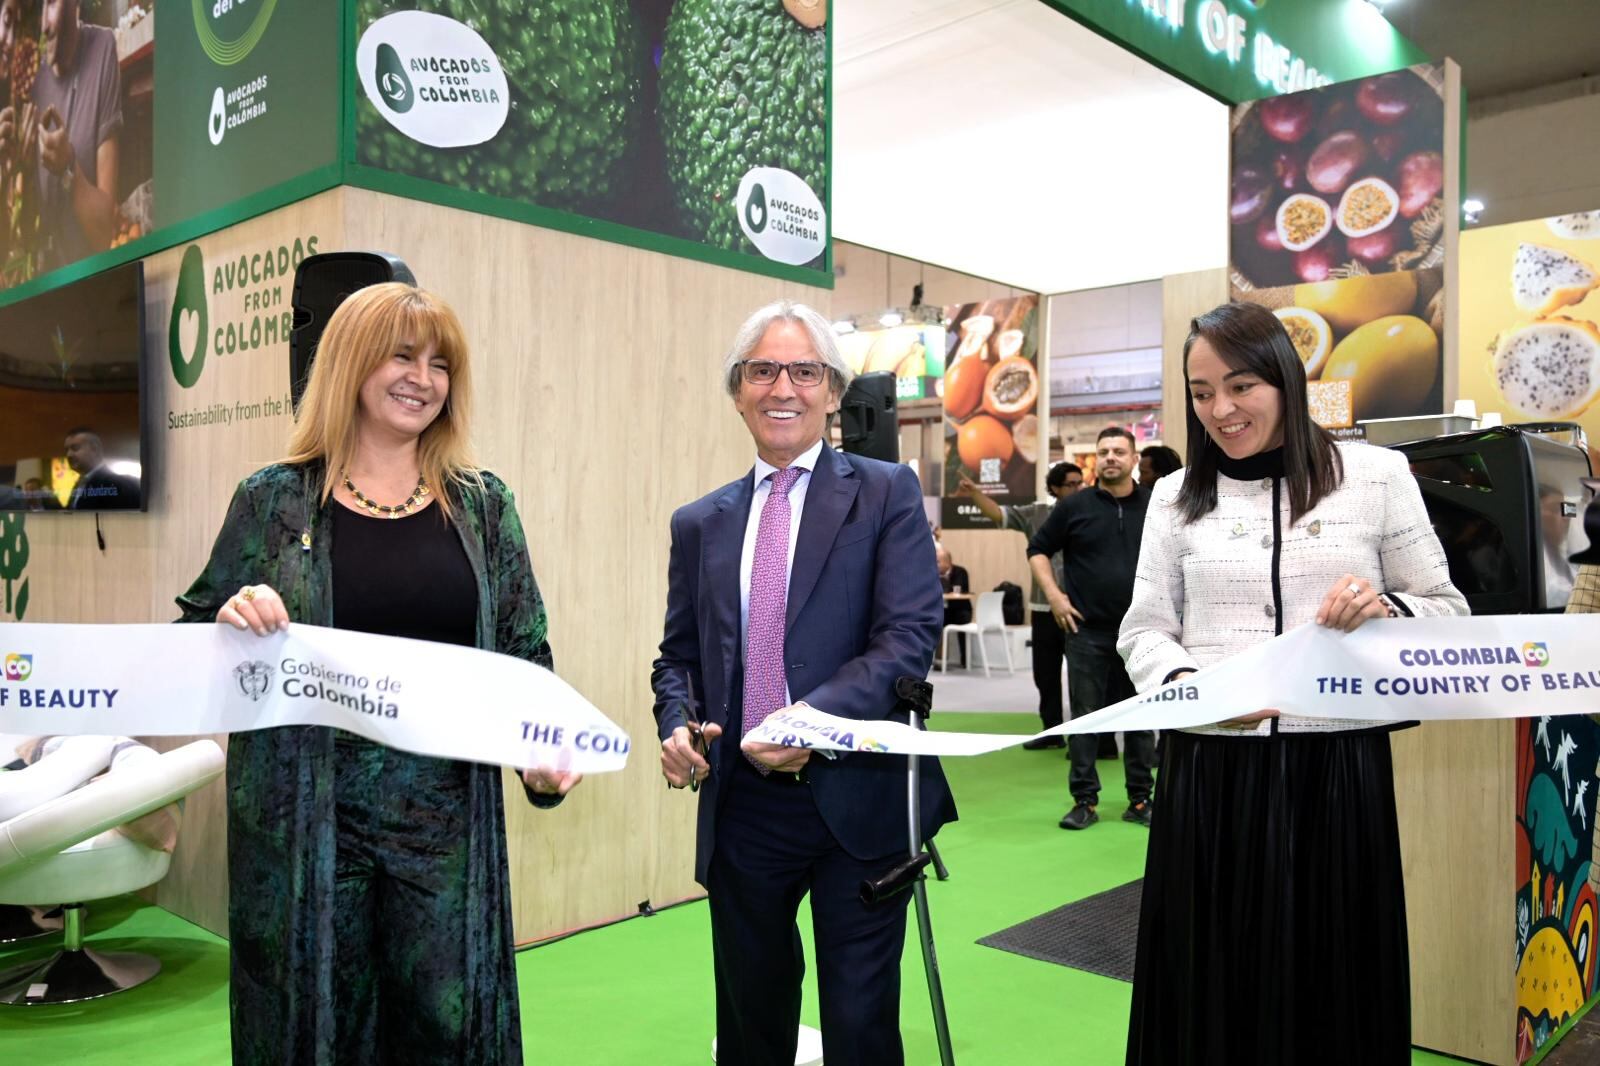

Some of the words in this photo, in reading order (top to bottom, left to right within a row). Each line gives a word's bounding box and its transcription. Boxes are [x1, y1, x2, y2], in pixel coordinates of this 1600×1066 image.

[1198, 0, 1247, 62] OF
[410, 57, 491, 73] AVOCADOS
[226, 75, 268, 106] AVOCADOS
[440, 75, 469, 85] FROM
[239, 96, 255, 109] FROM
[419, 87, 500, 103] COLOMBIA
[227, 101, 267, 129] COLOMBIA
[770, 199, 819, 221] AVOCADOS
[771, 219, 818, 242] COLOMBIA
[244, 286, 282, 313] FROM
[168, 403, 233, 430] Sustainability
[235, 401, 261, 421] from
[264, 396, 282, 417] the
[1400, 647, 1521, 666] COLOMBIA
[281, 658, 369, 689] Gobierno
[376, 675, 402, 693] de
[1316, 677, 1362, 695] THE
[1374, 675, 1490, 696] COUNTRY
[1501, 674, 1532, 692] OF
[19, 688, 119, 708] BEAUTY
[282, 678, 399, 719] Colombia
[521, 720, 565, 746] THE
